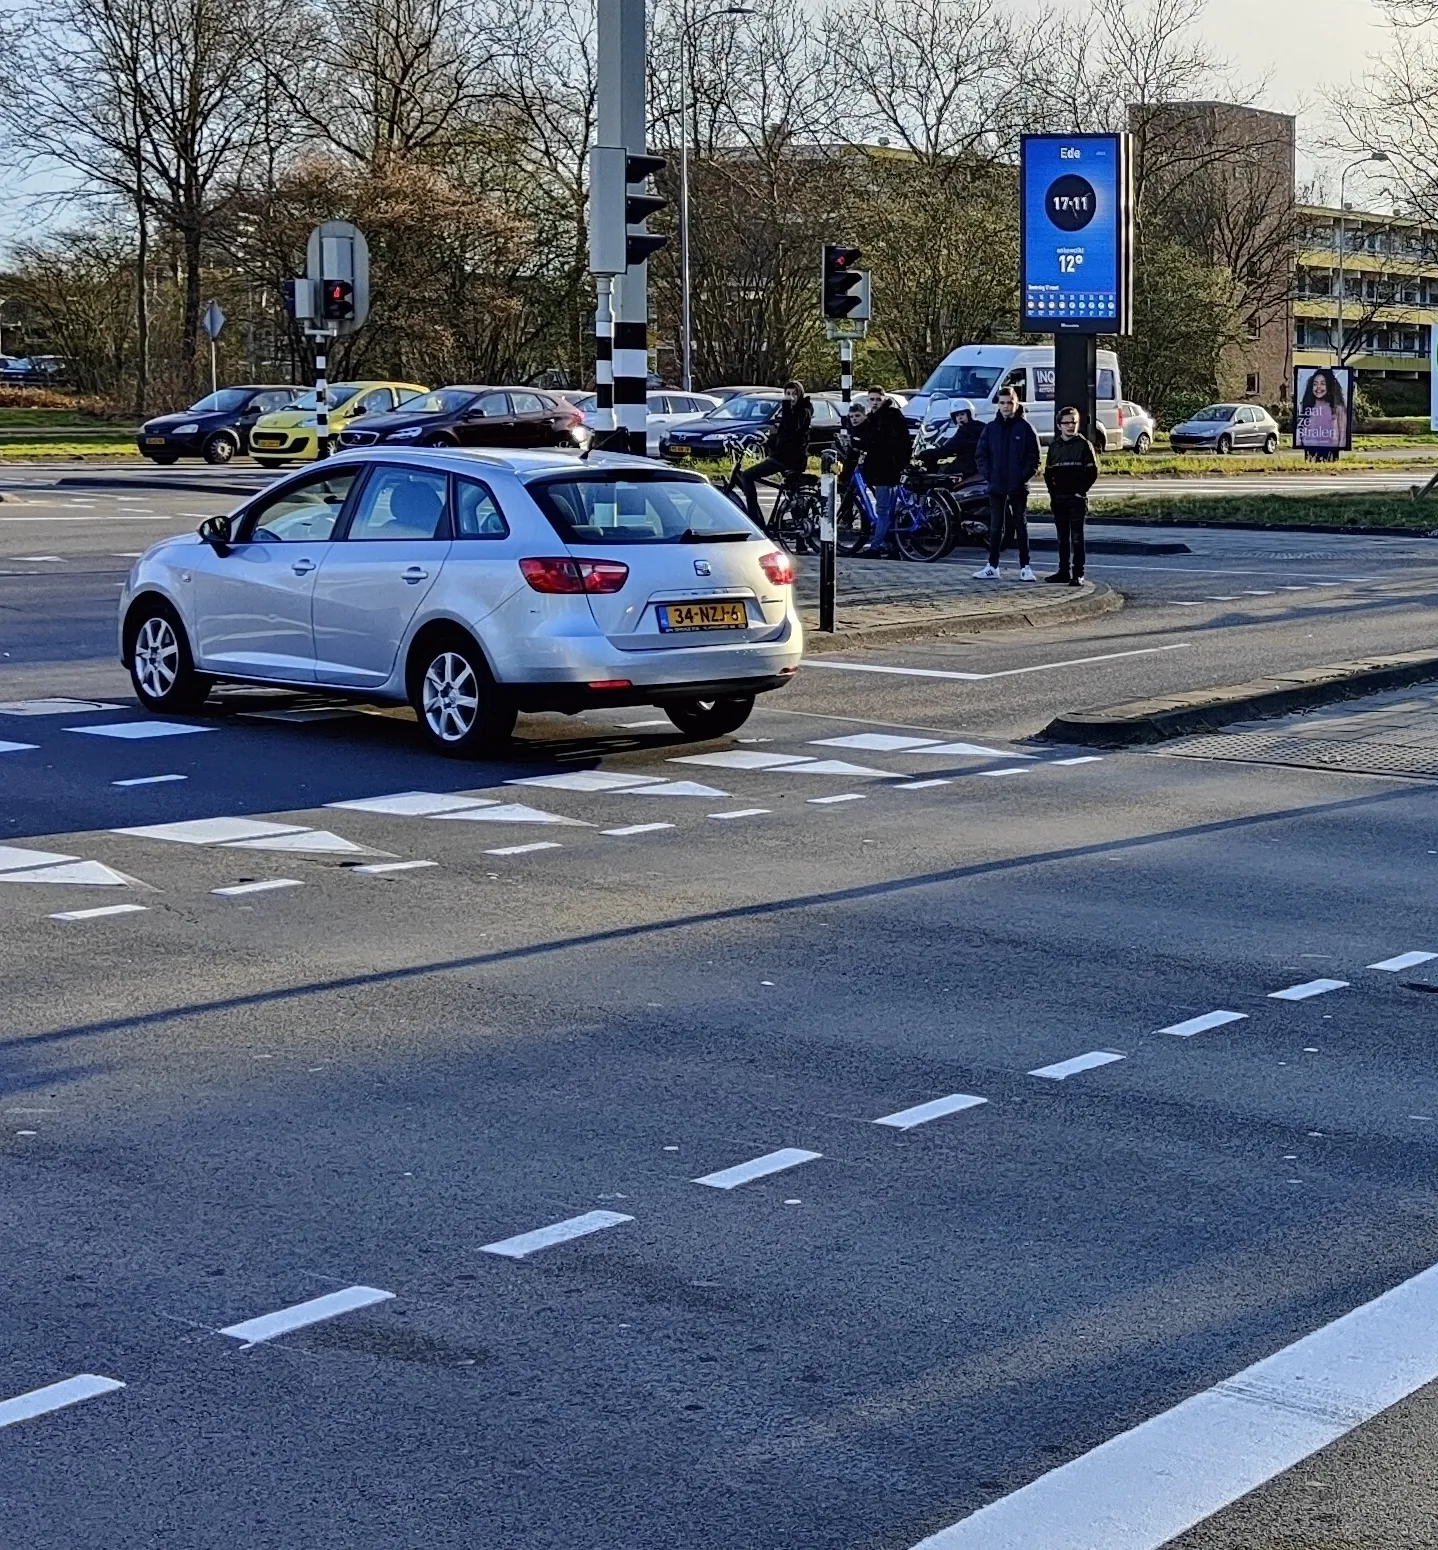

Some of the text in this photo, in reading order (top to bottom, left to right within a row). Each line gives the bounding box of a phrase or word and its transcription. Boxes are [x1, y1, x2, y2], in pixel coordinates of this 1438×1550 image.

[1060, 148, 1081, 159] Ede
[1298, 406, 1322, 416] Laat
[1299, 426, 1336, 438] stralen
[673, 606, 739, 624] 34-NZJ-6
